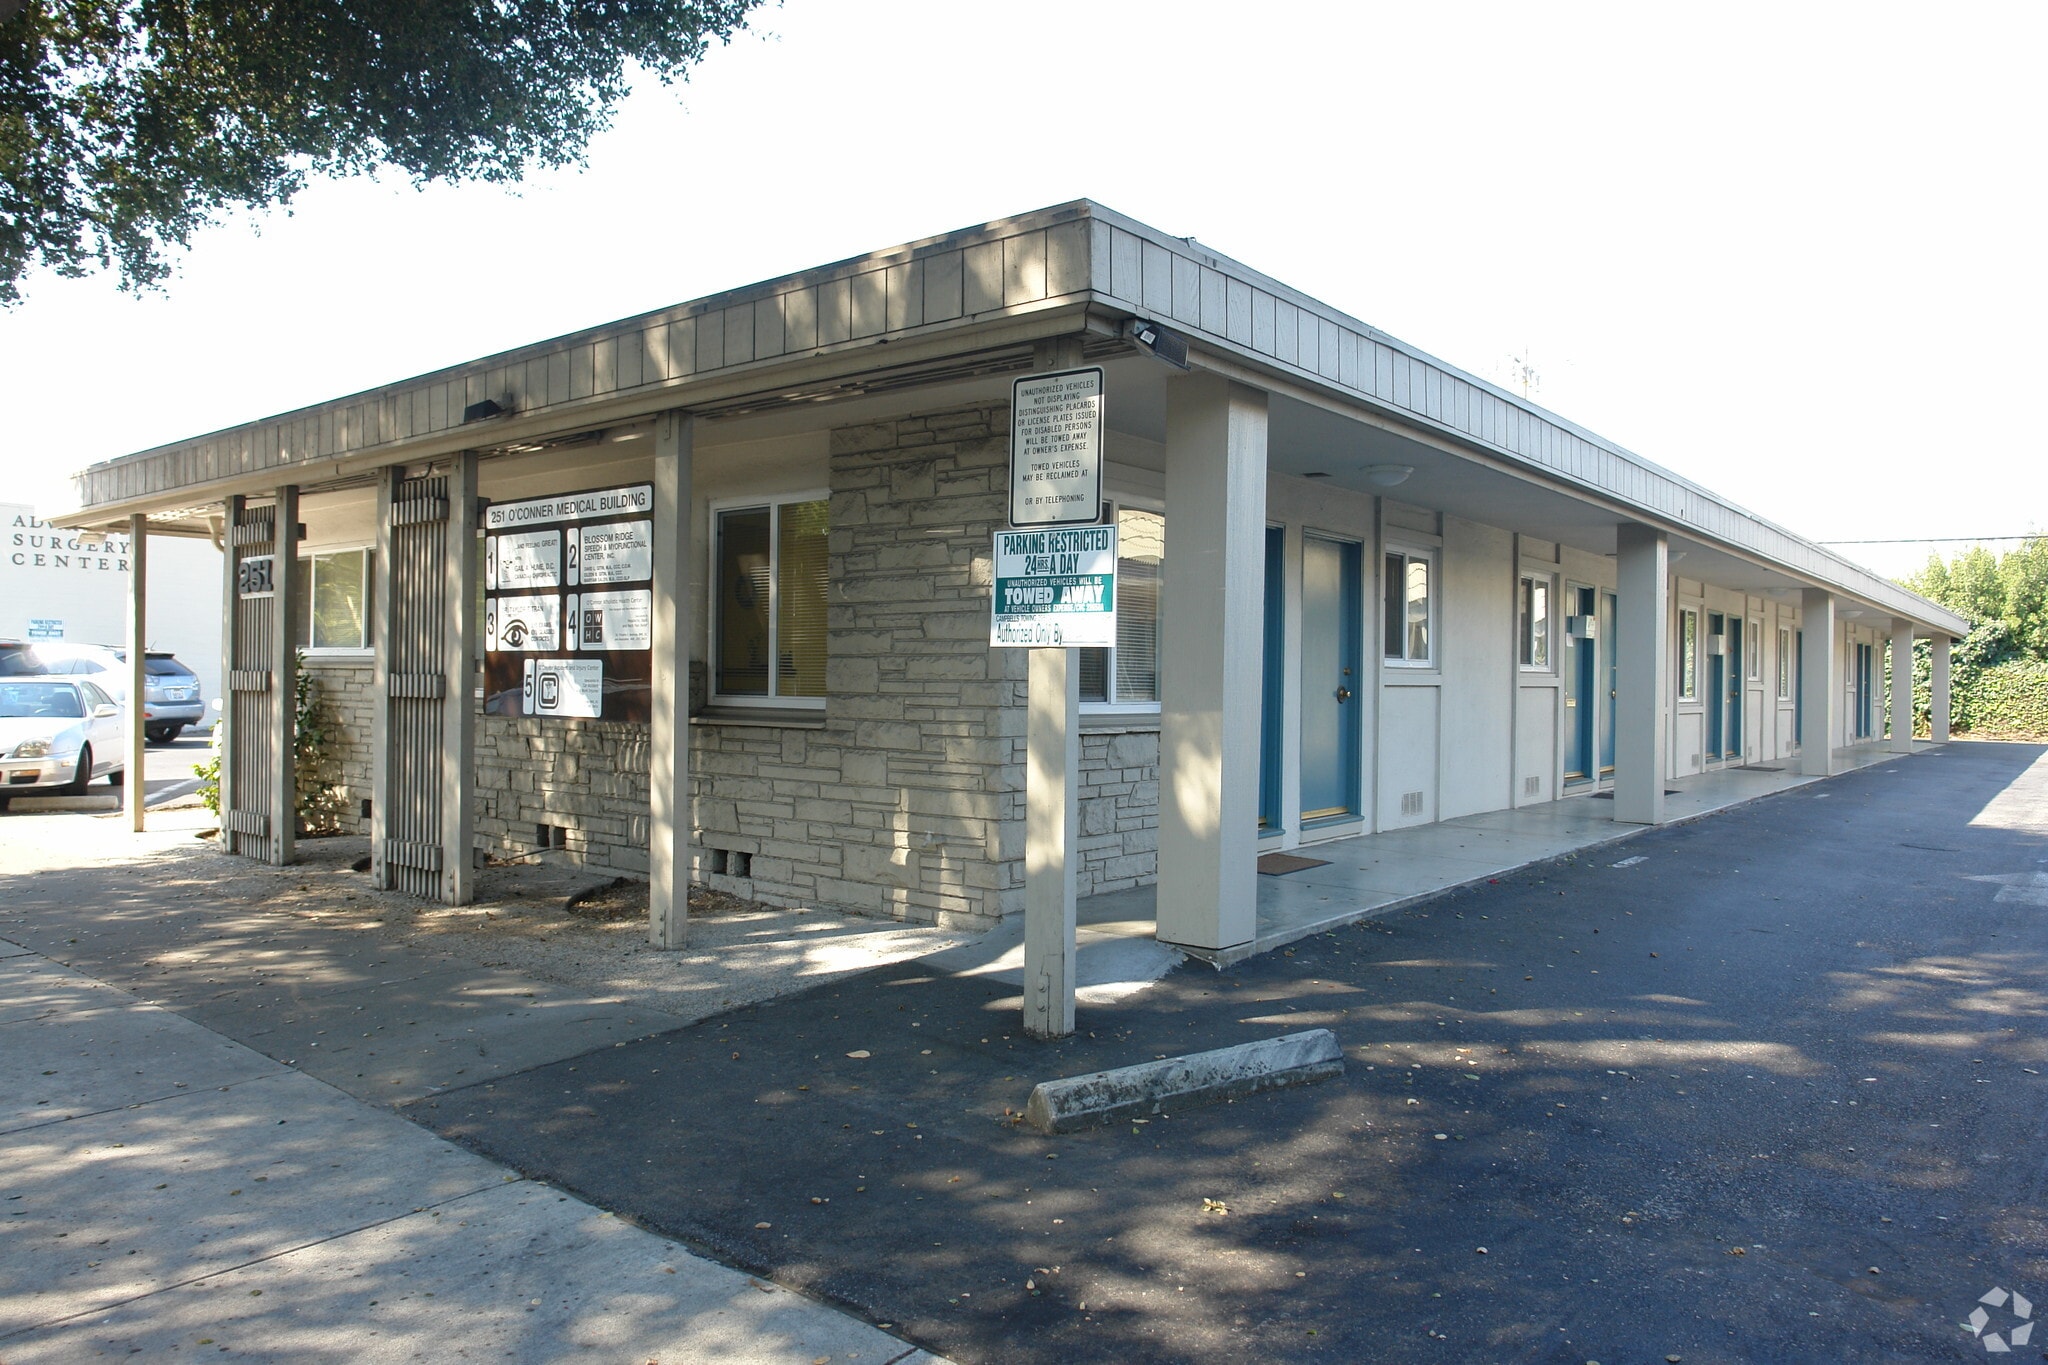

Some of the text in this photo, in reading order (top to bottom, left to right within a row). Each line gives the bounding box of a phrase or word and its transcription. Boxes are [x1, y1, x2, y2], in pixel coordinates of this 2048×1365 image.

[1021, 380, 1094, 397] UNAUTHORIZED VEHICLES
[1034, 392, 1080, 405] NOT DISPLAYING
[1018, 400, 1096, 417] DISTINGUISHING PLACARDS
[1017, 410, 1097, 427] OR LICENSE PLATES ISSUED
[1021, 421, 1092, 436] FOR DISABLED PERSONS
[1025, 432, 1087, 446] WILL BE TOWED AWAY
[1023, 442, 1089, 456] AT OWNER'S EXPENSE.
[1031, 459, 1080, 471] TOWED VEHICLES
[1022, 468, 1088, 482] MAY BE RECLAIMED AT
[491, 492, 646, 523] 251 O'CONNER MEDICAL BUILDING
[1025, 493, 1085, 505] OR BY TELEPHONING
[13, 533, 130, 554] SURGERY
[584, 531, 634, 544] BLOSSOM RIDGE
[584, 544, 603, 552] SPEECH
[608, 540, 647, 551] MYOFUNCTIONAL
[1004, 529, 1109, 555] PARKING RESTRICTED
[12, 553, 129, 571] CENTER
[487, 551, 493, 574] 1
[569, 544, 577, 569] 2
[1025, 555, 1037, 575] 24
[1049, 554, 1056, 575] A
[1060, 553, 1080, 574] DAY
[238, 559, 274, 594] 251
[1007, 576, 1103, 587] UNAUTHORIZED VEHICLES WILL BE
[1004, 585, 1105, 605] TOWED AWAY
[1004, 605, 1010, 613] AT
[487, 612, 495, 636] 3
[568, 610, 577, 634] 4
[996, 623, 1033, 643] Authorized
[1053, 623, 1064, 645] By
[525, 674, 533, 698] 5
